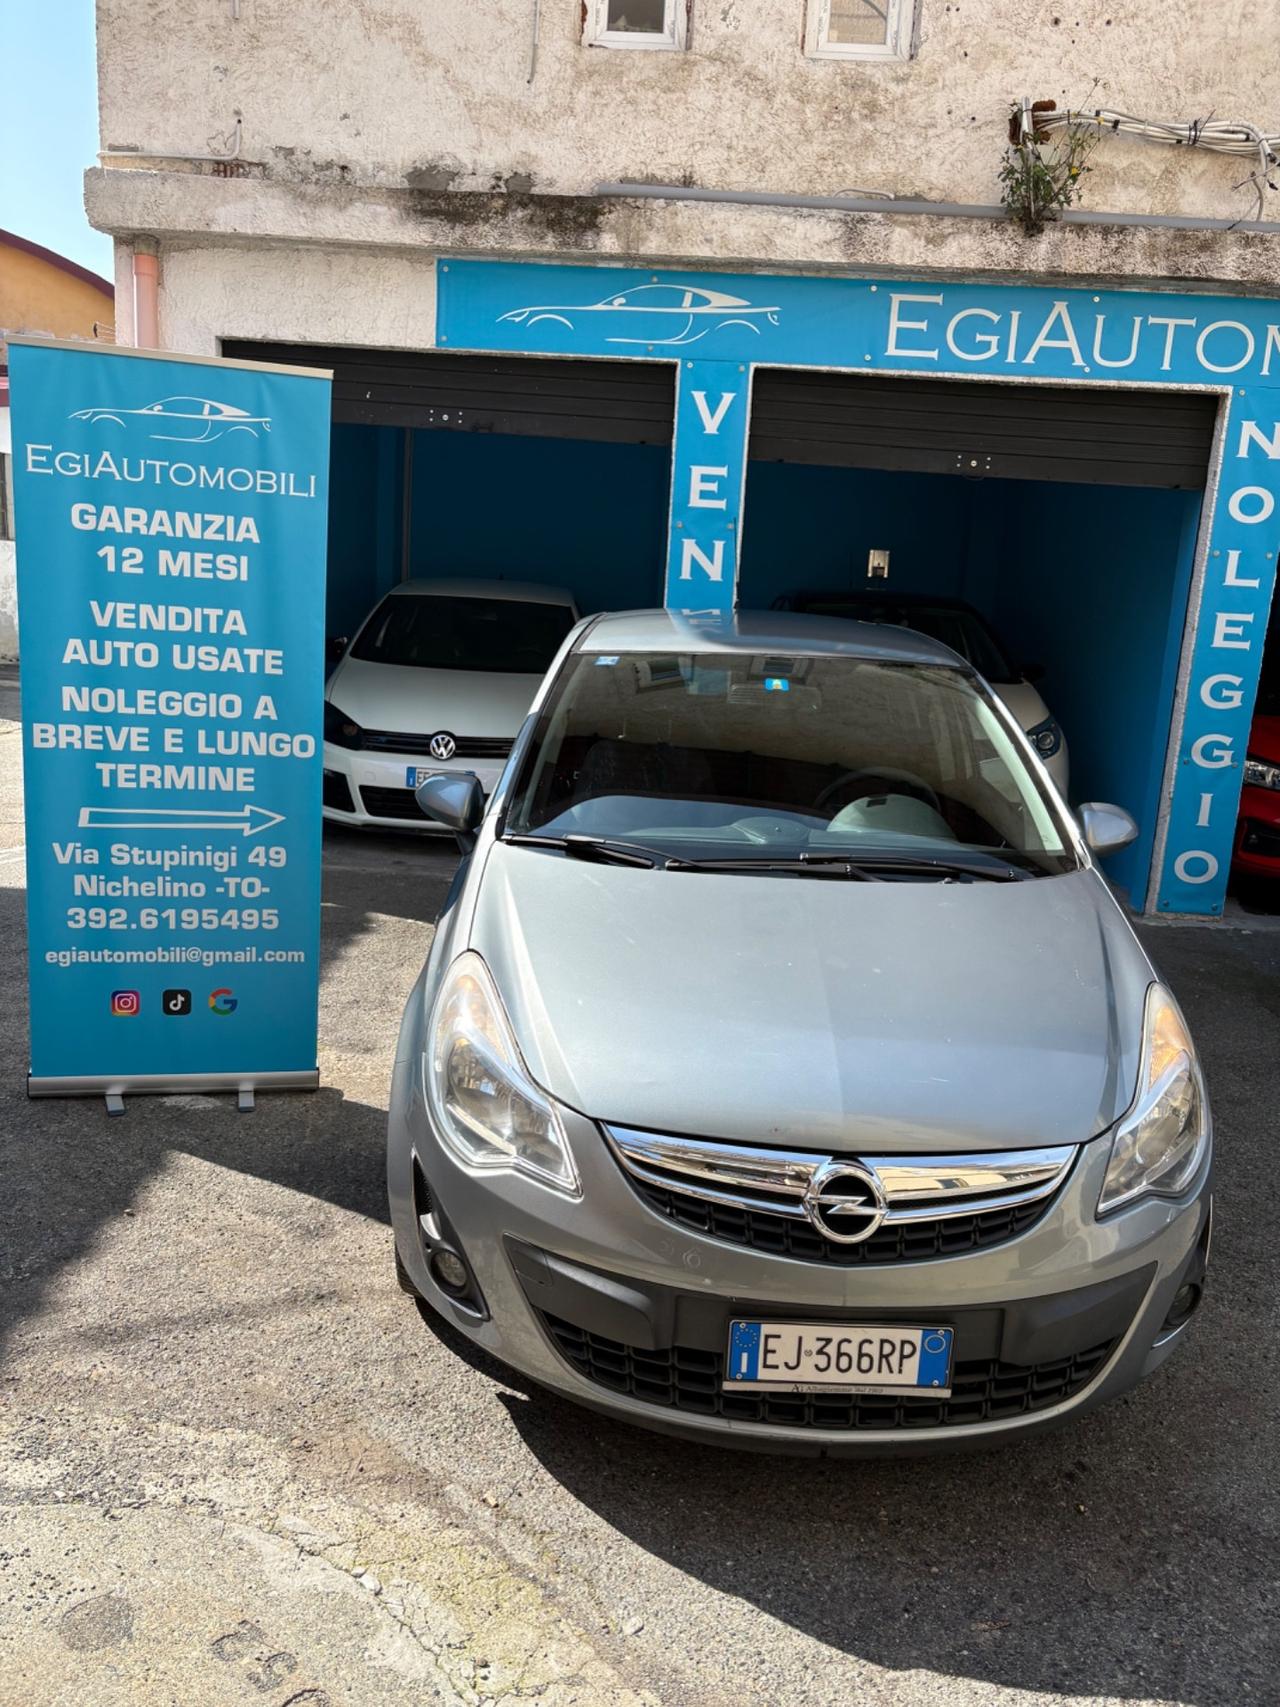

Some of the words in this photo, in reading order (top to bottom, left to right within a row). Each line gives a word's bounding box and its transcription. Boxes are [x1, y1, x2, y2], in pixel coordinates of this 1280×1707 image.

[71, 503, 260, 543] GARANZIA
[97, 546, 144, 574] 12
[159, 550, 248, 581] MESI
[90, 601, 247, 635] VENDITA
[63, 639, 158, 667] AUTO
[173, 645, 284, 675] USATE
[1173, 420, 1280, 885] NOLEGGIO
[62, 686, 242, 718] NOLEGGIO
[254, 696, 277, 720] A
[33, 724, 149, 751] BREVE
[165, 729, 183, 752] E
[198, 730, 315, 758] LUNGO
[96, 763, 254, 791] TERMINE
[52, 843, 99, 865] Via
[110, 844, 237, 872] Stupinigi
[248, 846, 287, 868] 49
[74, 875, 206, 898] Nichelino
[216, 878, 270, 898] -TO-
[67, 908, 279, 930] 392.6195495
[45, 947, 305, 966] egiautomobili@gmail.com
